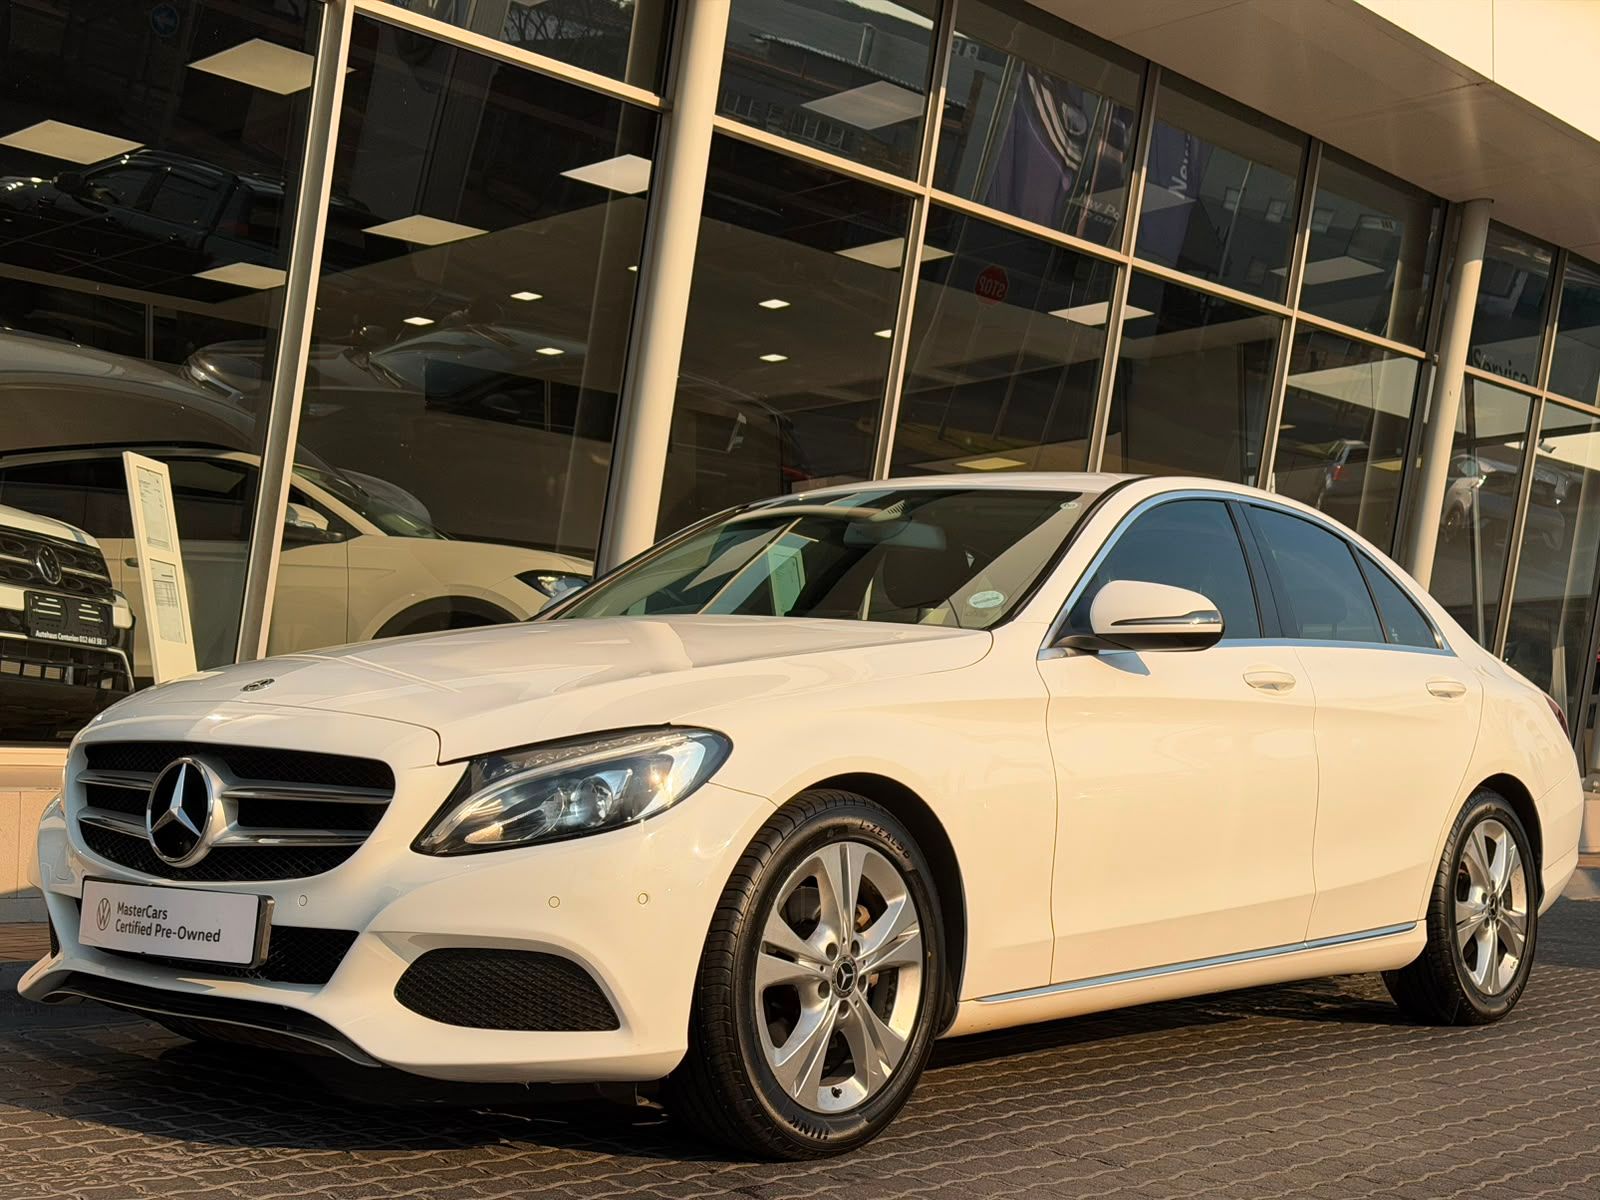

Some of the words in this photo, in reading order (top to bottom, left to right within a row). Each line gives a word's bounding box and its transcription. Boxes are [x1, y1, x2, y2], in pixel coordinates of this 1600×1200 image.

[35, 629, 58, 640] Autohaus
[58, 632, 79, 643] Centurion
[116, 902, 168, 920] MasterCars
[115, 918, 152, 936] Certified
[154, 925, 221, 943] Pre-Owned
